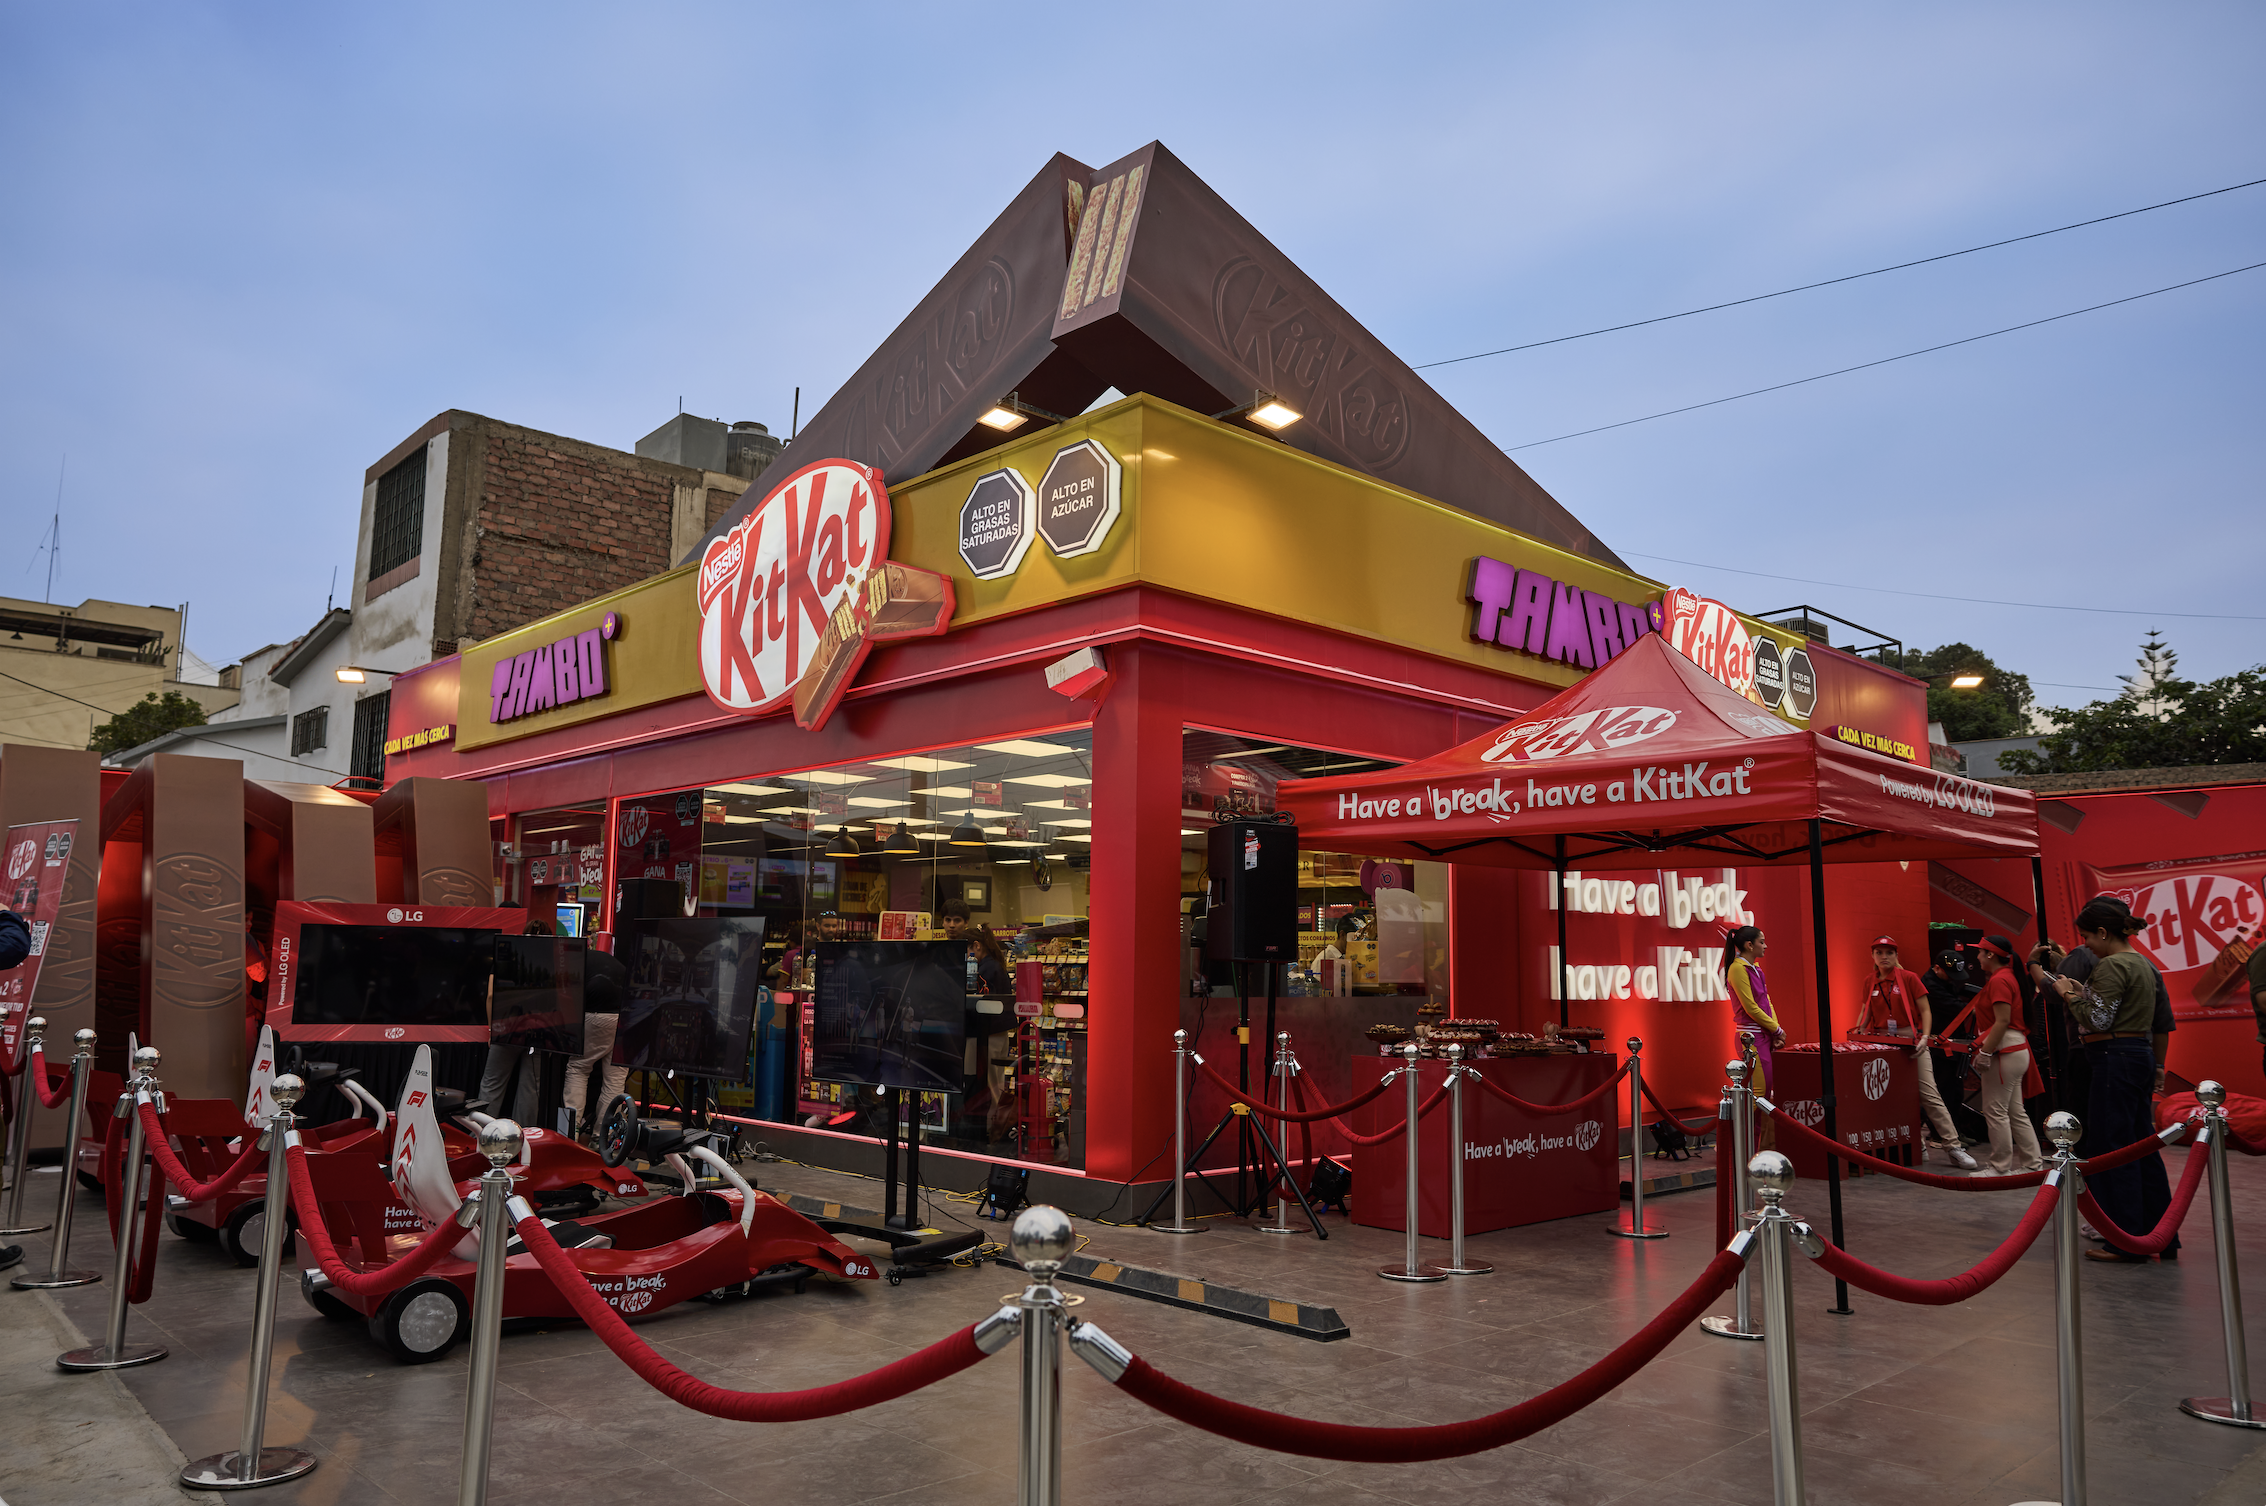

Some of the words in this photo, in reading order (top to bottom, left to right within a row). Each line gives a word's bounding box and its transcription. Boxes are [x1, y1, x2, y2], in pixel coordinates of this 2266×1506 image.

[1051, 482, 1078, 501] ALTO
[1080, 476, 1095, 492] EN
[971, 504, 996, 521] ALTO
[997, 499, 1011, 514] EN
[1051, 494, 1094, 519] AZÚCAR
[971, 513, 1011, 534] GRASAS
[962, 523, 1019, 550] SATURADAS
[704, 537, 742, 592] Nestlé
[1759, 657, 1771, 668] ALTO
[1771, 661, 1779, 671] EN
[1759, 666, 1780, 679] GRASAS
[1756, 674, 1784, 691] SATURADAS
[1792, 671, 1804, 682] ALTO
[1804, 675, 1811, 684] EN
[1793, 683, 1811, 696] AZÚCAR
[384, 737, 402, 756] CADA
[401, 735, 414, 751] VEZ
[414, 728, 429, 748] MÁS
[429, 724, 450, 744] CERCA
[1837, 724, 1861, 746] CADA
[1861, 731, 1876, 750] VEZ
[1877, 735, 1893, 755] MÁS
[1893, 742, 1916, 761] CERCA
[1338, 792, 1400, 820] Have
[1406, 796, 1421, 817] a
[1427, 778, 1521, 823] break,
[1527, 779, 1596, 808] have
[1606, 782, 1625, 802] a
[1879, 774, 1921, 802] Powered
[1921, 786, 1934, 809] by
[1934, 775, 1955, 809] LG
[1957, 781, 1995, 818] OLED
[621, 806, 648, 846] KitKat
[644, 866, 666, 879] GANA
[1549, 869, 1636, 914] Have
[1636, 883, 1660, 917] a
[405, 910, 423, 922] LG
[280, 936, 290, 963] OLED
[279, 962, 288, 976] LG
[1549, 945, 1631, 1001] have
[1634, 963, 1659, 1000] a
[281, 976, 288, 986] by
[278, 986, 287, 1006] Powered
[1465, 1141, 1493, 1160] Have
[1495, 1144, 1502, 1156] a
[1503, 1132, 1539, 1159] break,
[1541, 1133, 1564, 1151] have
[1566, 1135, 1573, 1147] a
[627, 1184, 638, 1193] LG
[384, 1206, 415, 1218] Have
[384, 1218, 413, 1229] have
[413, 1219, 421, 1228] a
[857, 1265, 870, 1276] LG
[614, 1282, 623, 1292] a
